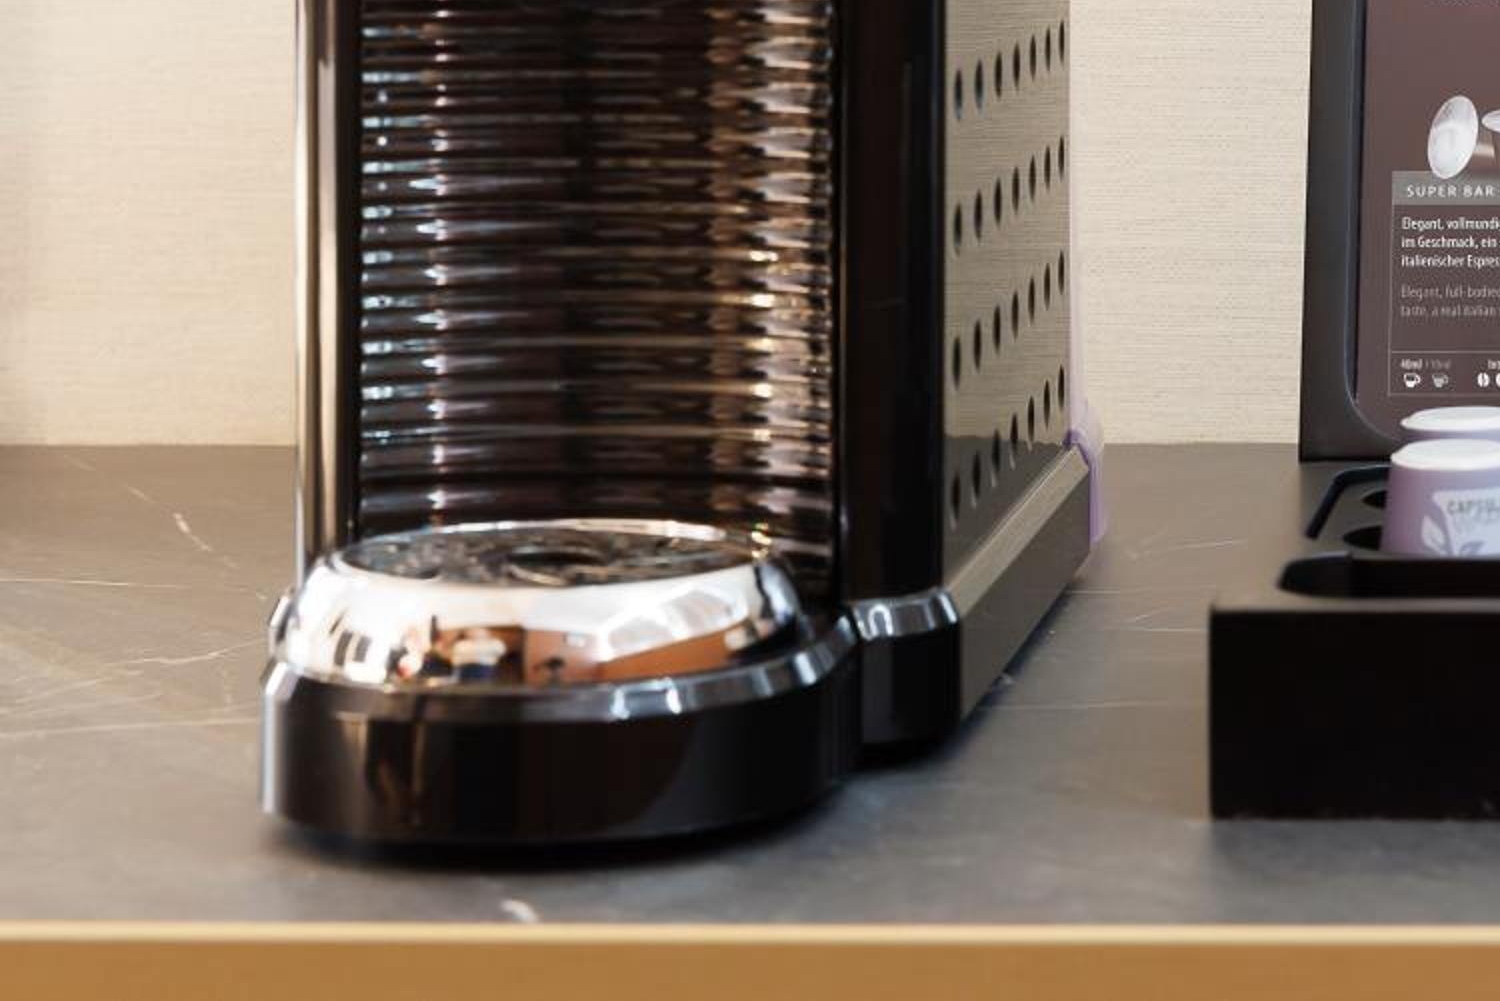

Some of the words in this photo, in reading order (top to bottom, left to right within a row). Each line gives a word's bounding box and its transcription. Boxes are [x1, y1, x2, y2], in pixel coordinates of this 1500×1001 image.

[1406, 184, 1458, 198] SUPER
[1462, 184, 1495, 198] BAR
[1401, 216, 1445, 232] Elegant,
[1401, 236, 1416, 248] im
[1417, 235, 1479, 250] Geschmack,
[1481, 235, 1498, 248] ein
